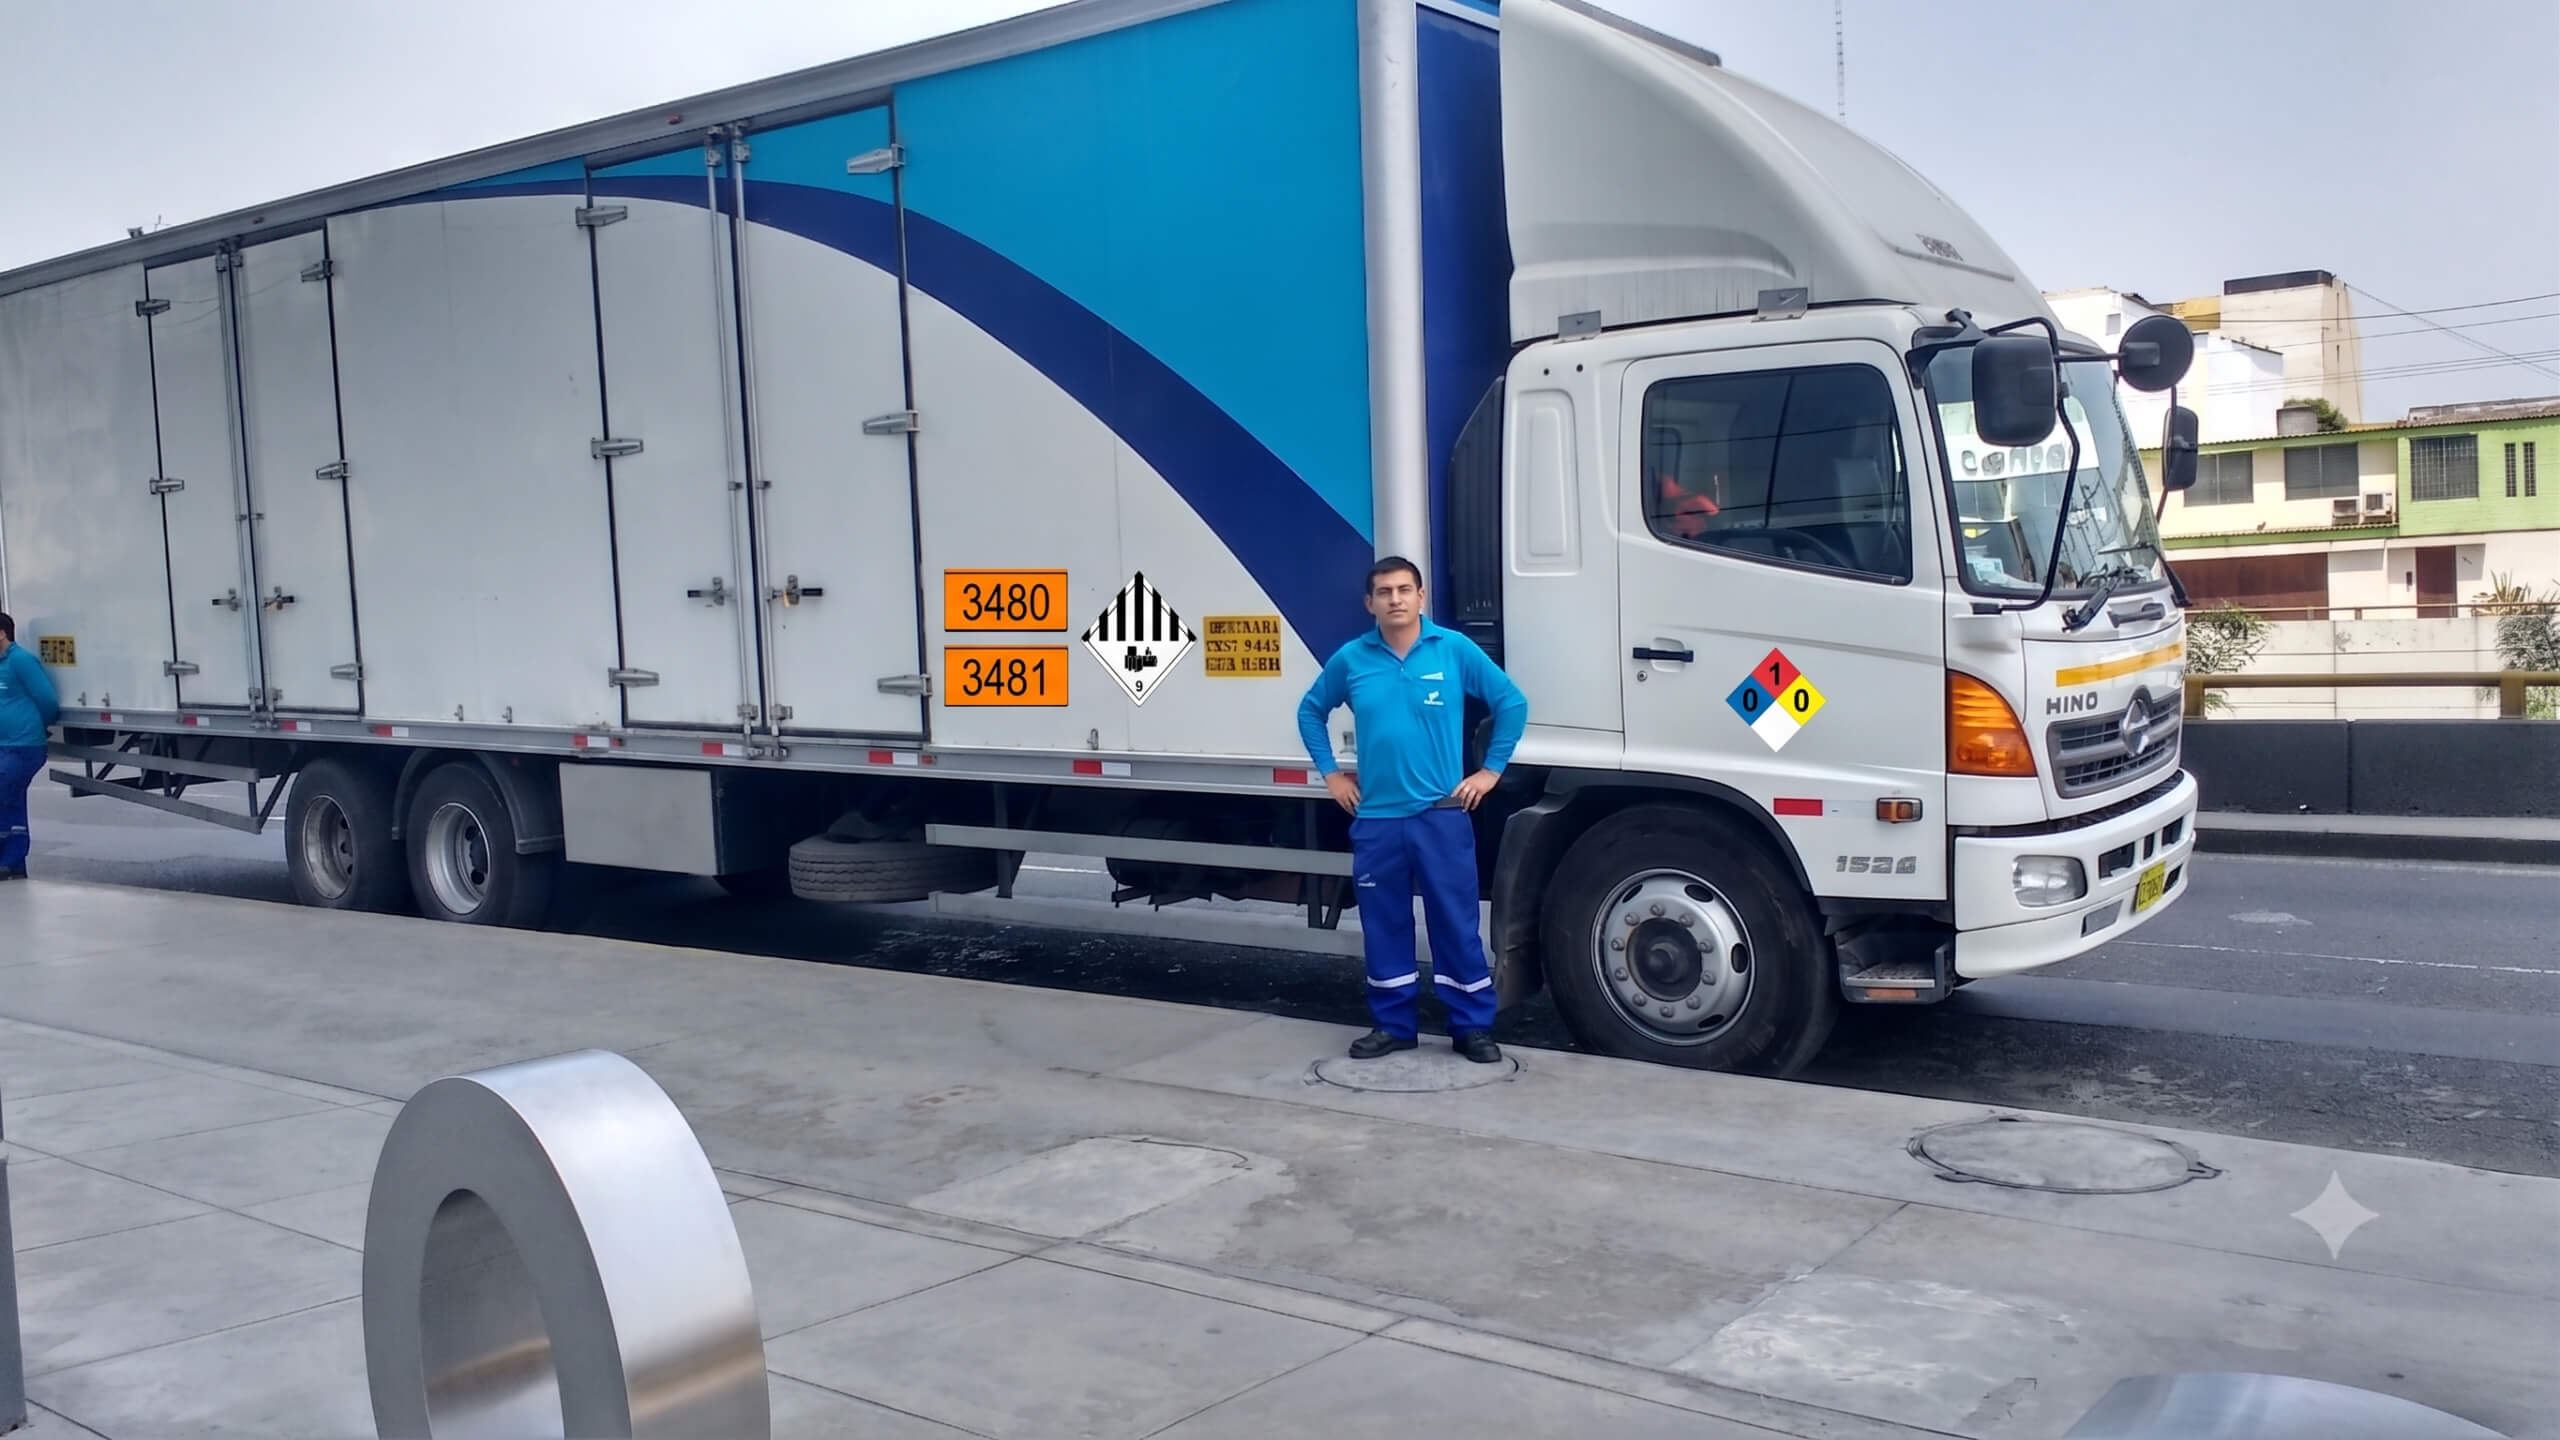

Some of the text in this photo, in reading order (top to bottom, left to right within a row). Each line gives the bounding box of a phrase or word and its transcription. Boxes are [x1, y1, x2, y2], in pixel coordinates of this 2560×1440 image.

[962, 582, 1050, 622] 3480
[962, 658, 1046, 697] 3481
[1135, 680, 1144, 693] 9
[1769, 661, 1780, 686] 1
[1742, 687, 1759, 713] 0
[1793, 687, 1810, 713] 0
[2046, 691, 2099, 715] HINO
